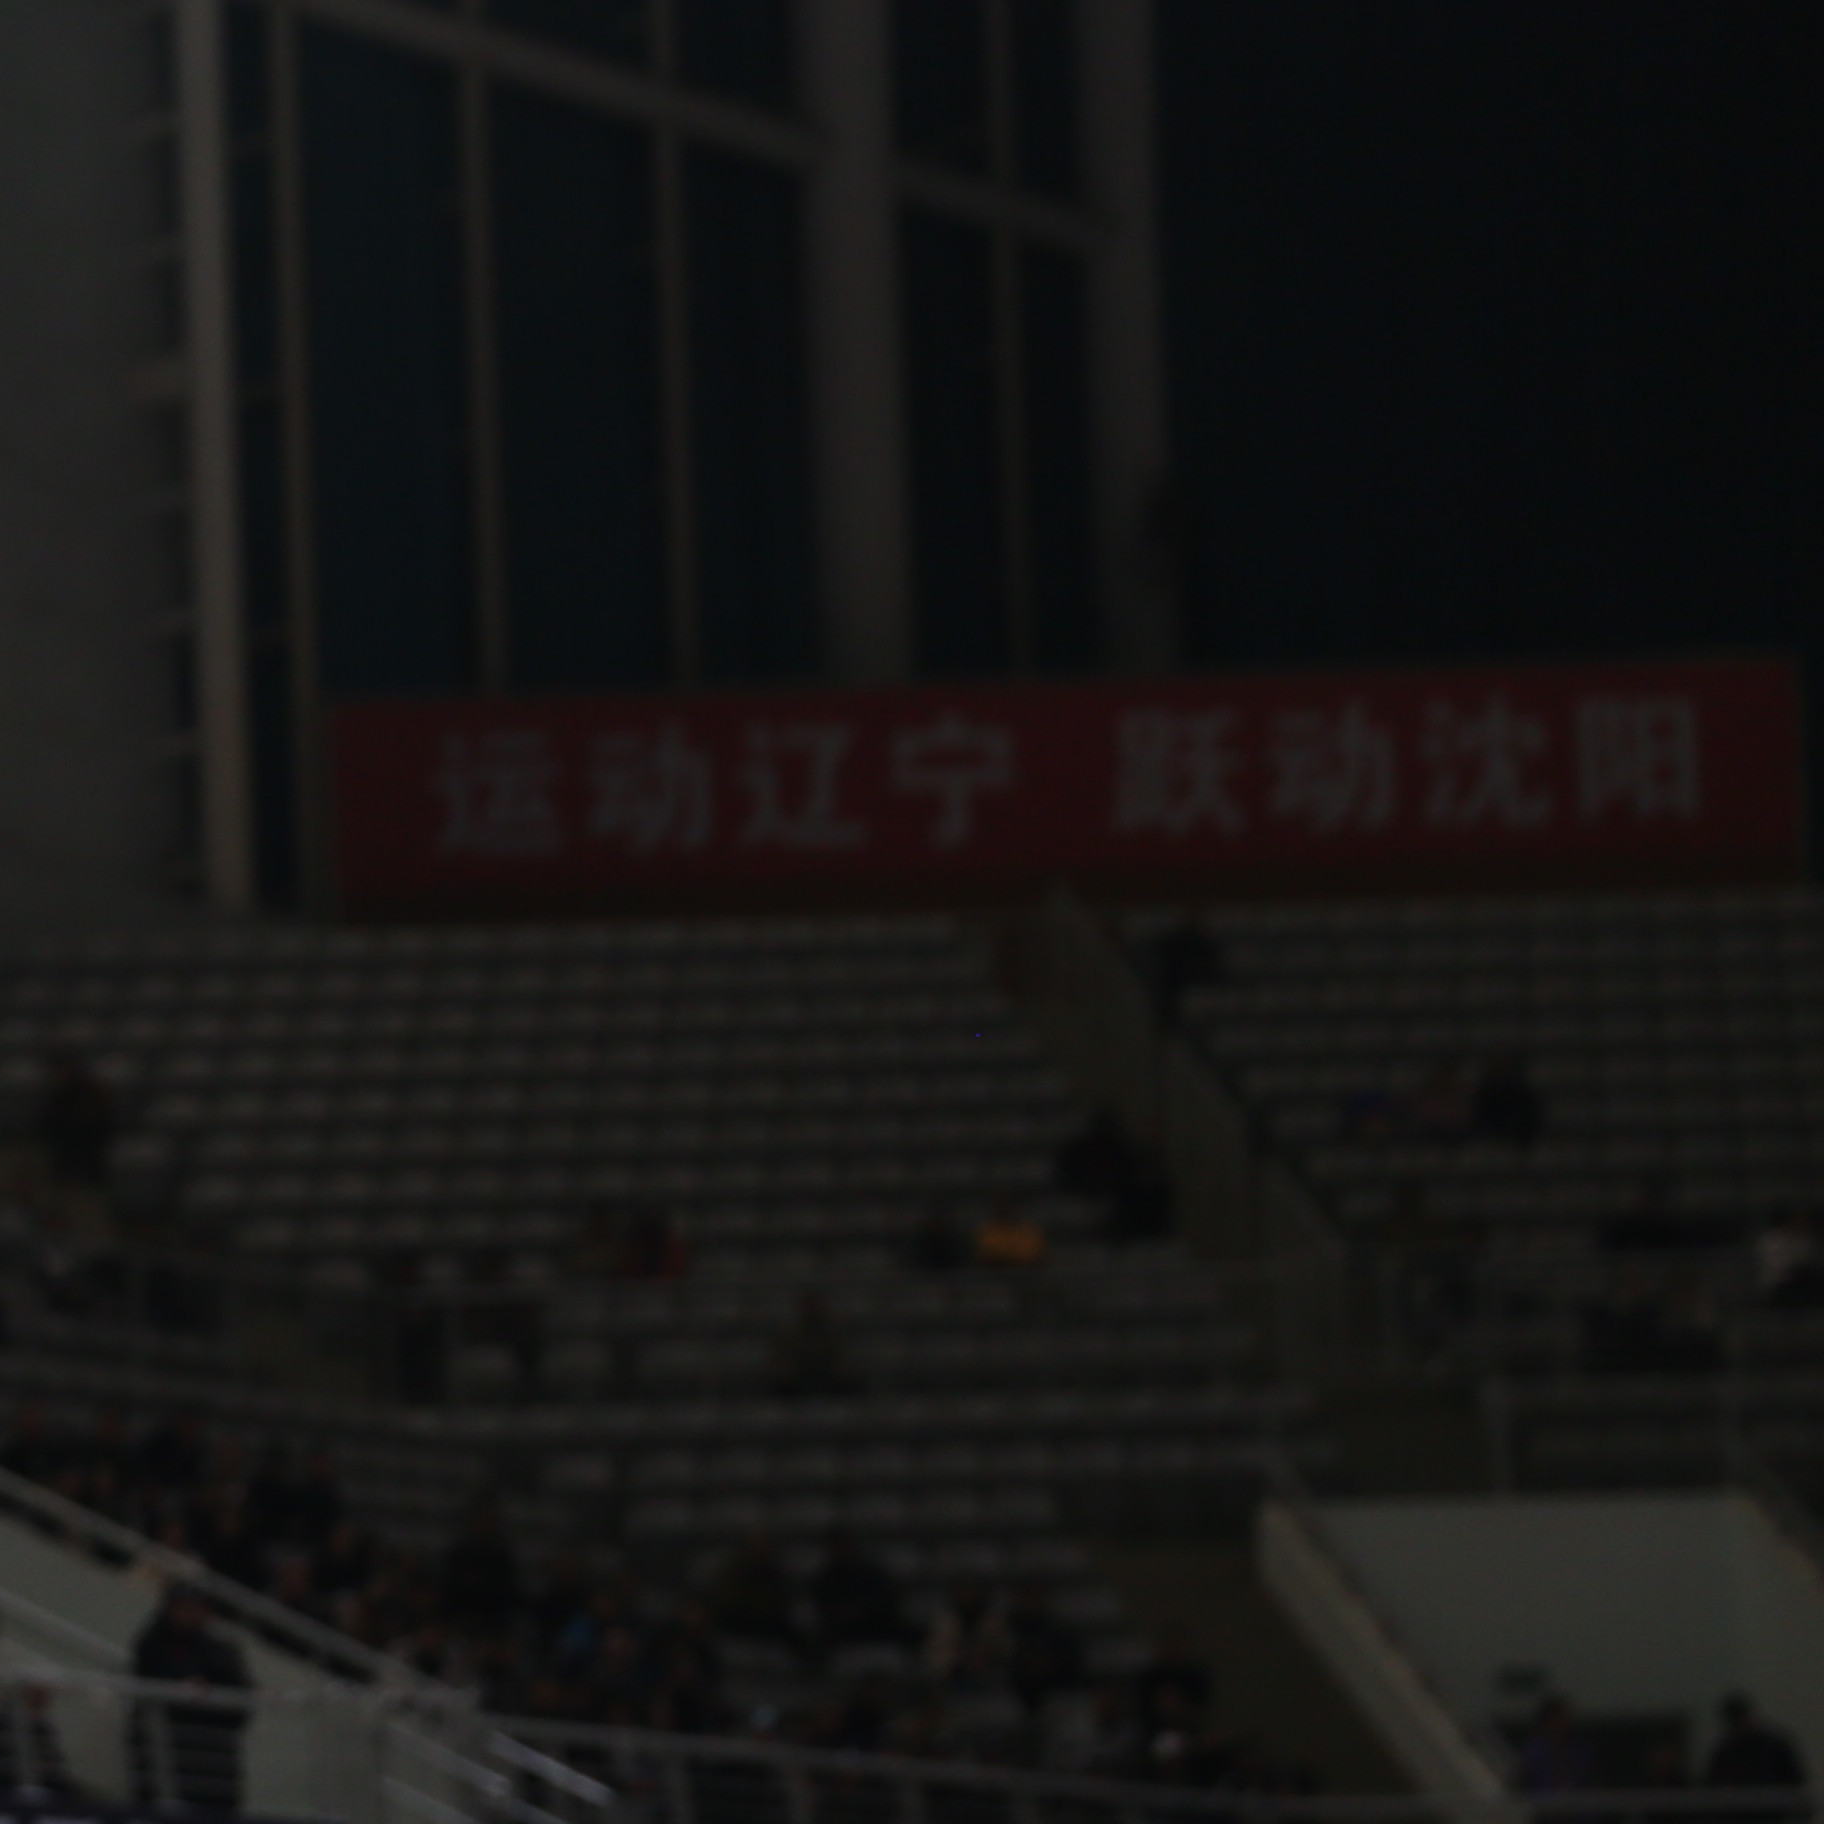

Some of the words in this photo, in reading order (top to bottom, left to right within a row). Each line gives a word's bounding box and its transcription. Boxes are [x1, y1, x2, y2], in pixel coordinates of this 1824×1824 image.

[428, 712, 1020, 860] 运动辽宁
[1108, 692, 1706, 840] 跃动沈阳
